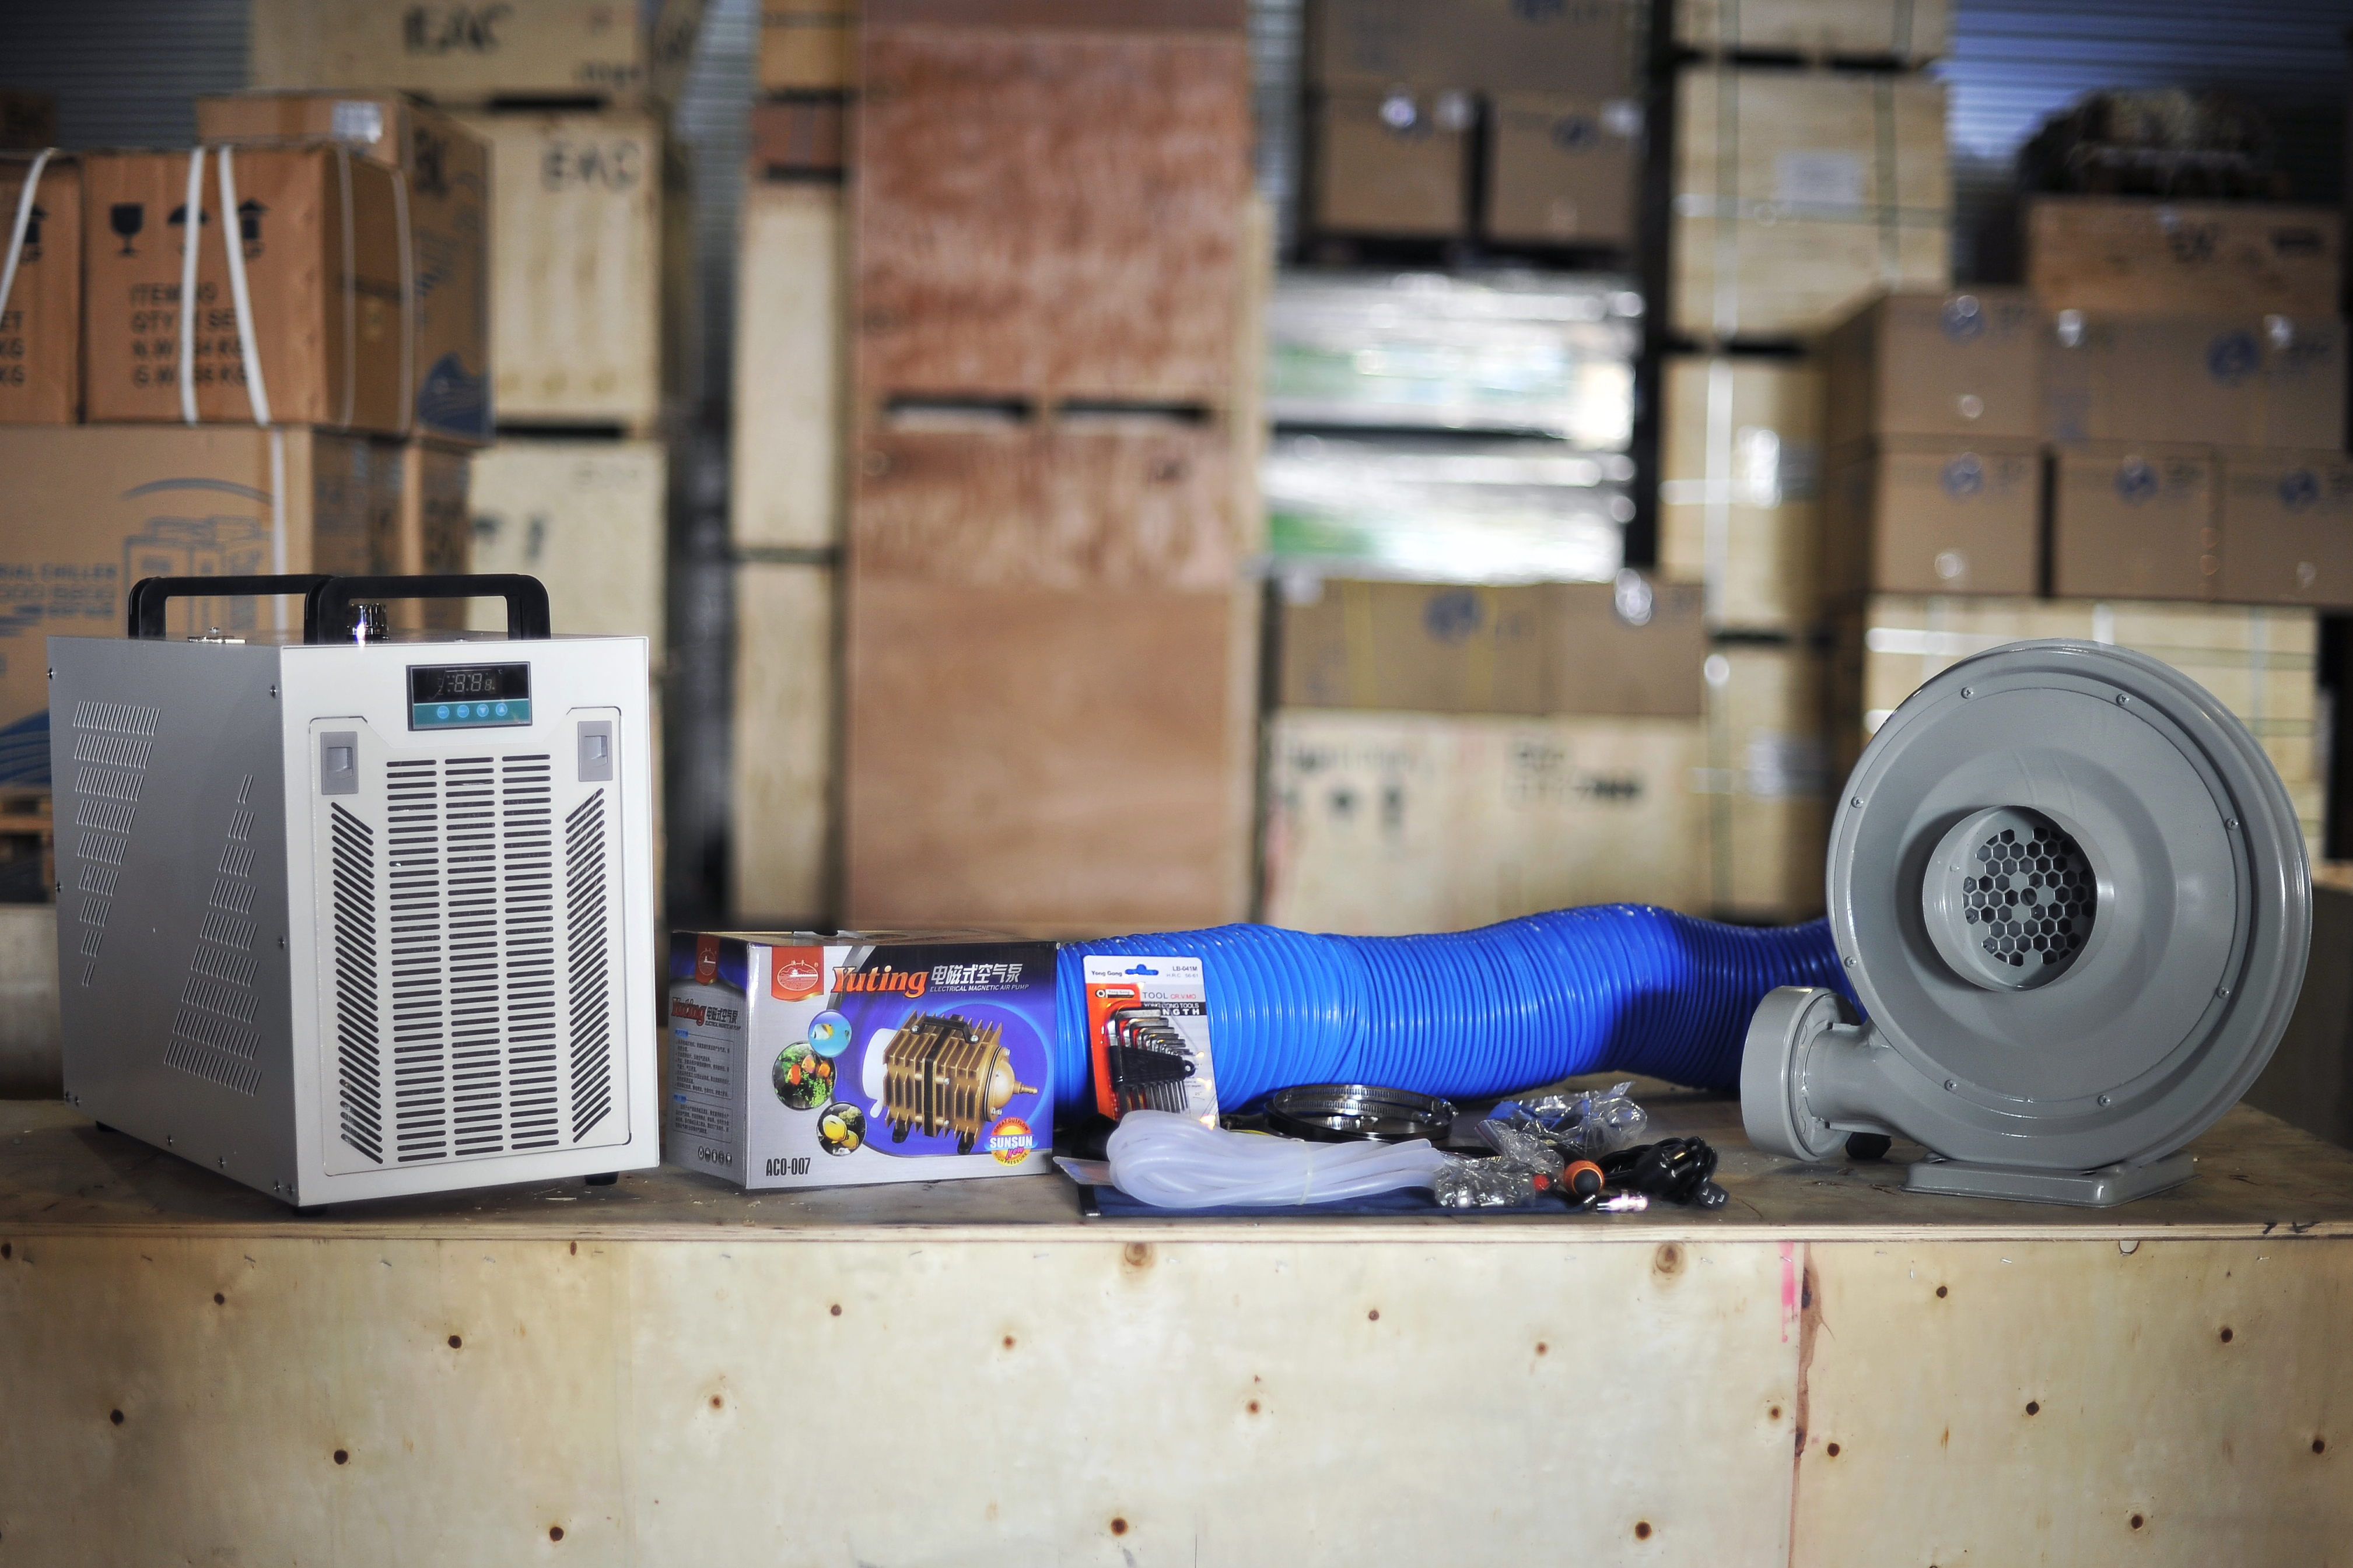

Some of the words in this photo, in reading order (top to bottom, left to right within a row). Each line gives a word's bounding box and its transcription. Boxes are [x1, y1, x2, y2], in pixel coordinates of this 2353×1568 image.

[931, 963, 1023, 985] 电磁式空气泵
[832, 965, 929, 999] Yuting
[994, 1119, 1007, 1133] GREAT
[1008, 1118, 1029, 1131] OUTFLOW
[990, 1135, 1033, 1149] SUNSUN
[994, 1152, 1004, 1163] HIGH
[1004, 1152, 1028, 1165] PRESSURE
